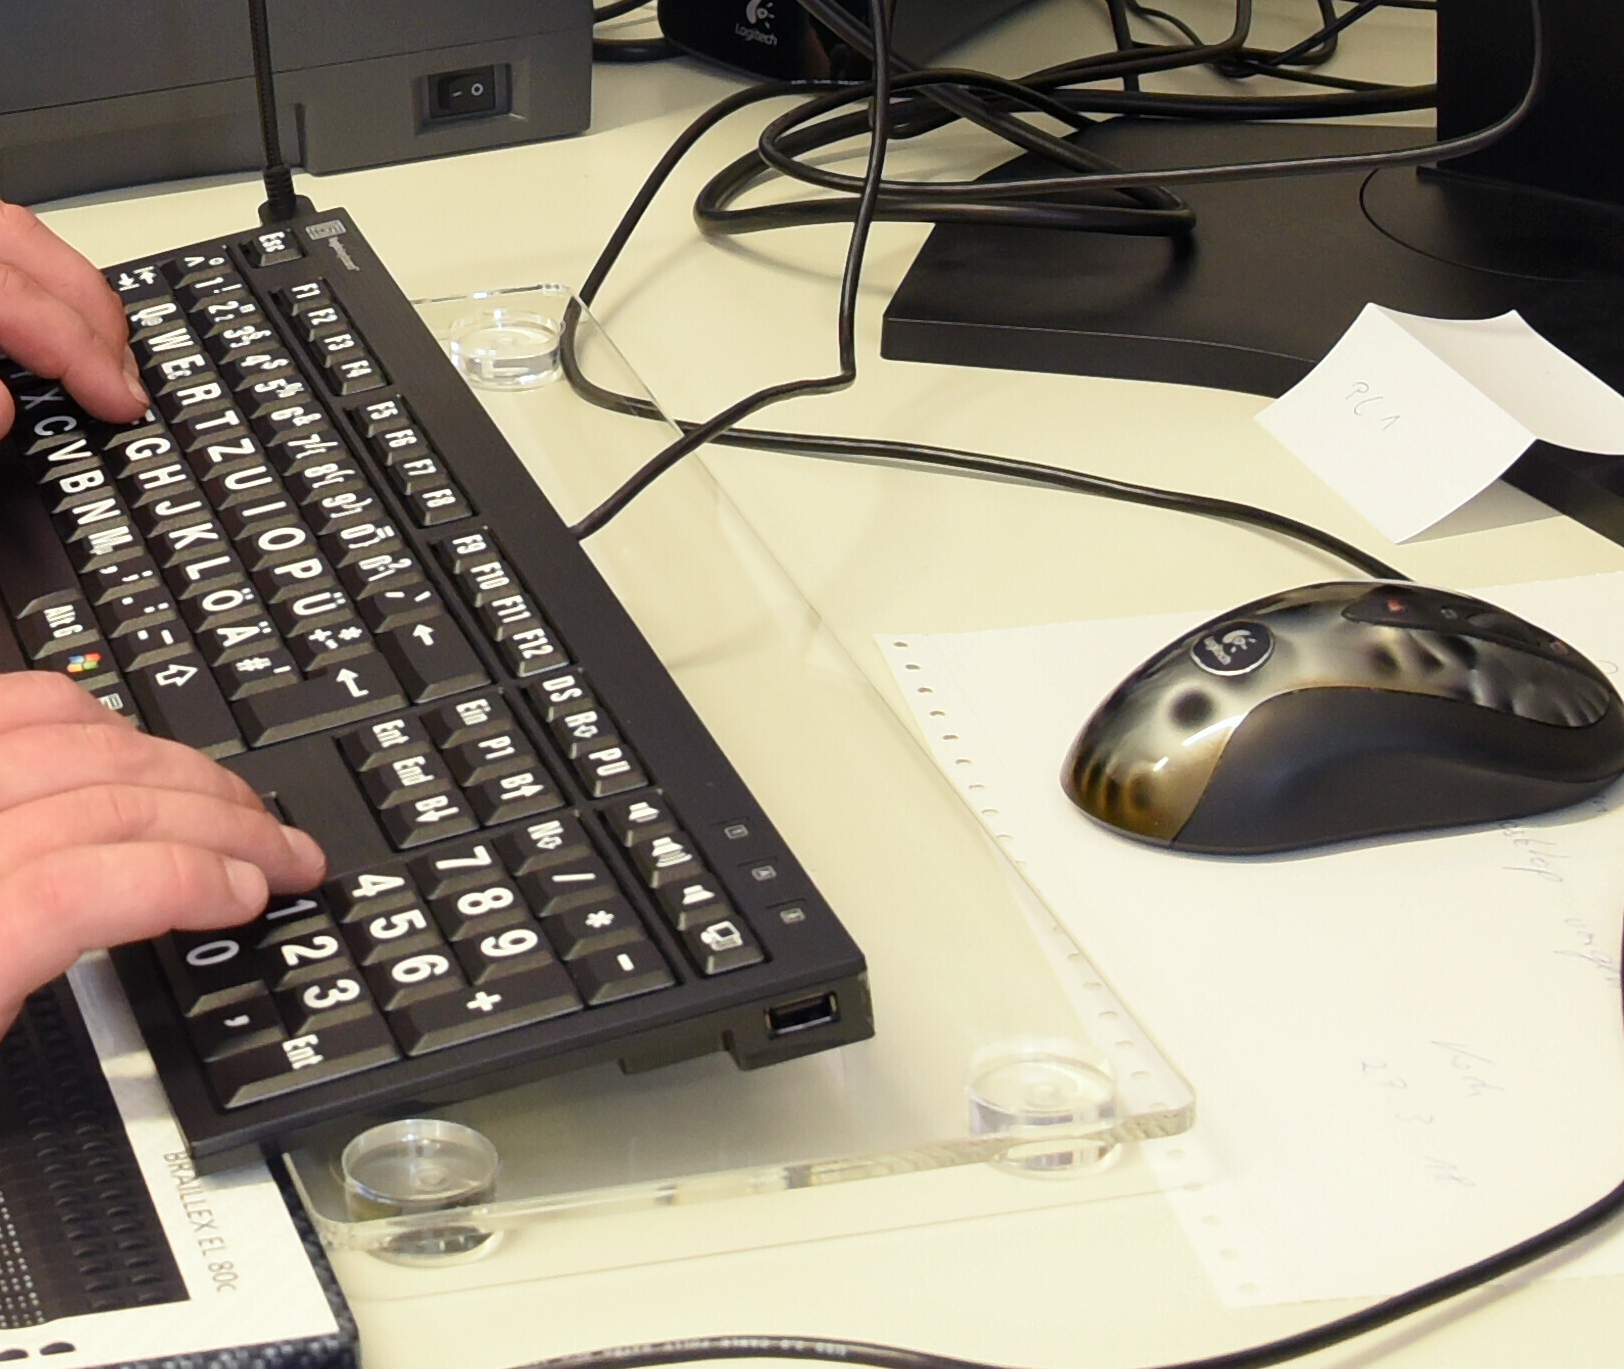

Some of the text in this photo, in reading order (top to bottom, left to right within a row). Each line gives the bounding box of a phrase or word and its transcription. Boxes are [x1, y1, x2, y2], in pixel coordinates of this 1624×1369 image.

[259, 232, 285, 252] Esc
[148, 327, 195, 352] W
[292, 283, 373, 379] F1 F2 F3 F4
[20, 387, 65, 410] X
[177, 382, 222, 406] R
[34, 416, 77, 436] C
[195, 409, 241, 431] T
[48, 438, 93, 462] V
[125, 437, 171, 462] G
[207, 437, 256, 463] Z
[367, 400, 457, 509] F5 F6 F7 F8
[60, 469, 105, 494] B
[138, 463, 187, 490] H
[225, 465, 273, 490] U
[72, 497, 122, 525] N
[155, 500, 203, 516] J
[242, 500, 287, 517] I
[169, 522, 220, 550] K
[258, 526, 307, 551] O
[185, 555, 231, 581] L
[274, 557, 323, 579] P
[201, 587, 255, 612] Ö
[293, 591, 347, 616] Ü
[451, 533, 554, 660] F9 F10 F11 F12
[217, 621, 272, 648] Ä
[455, 698, 492, 726] Ein
[542, 674, 583, 703] DS
[588, 747, 631, 777] PU
[435, 845, 493, 870] 7
[456, 887, 515, 916] 8
[351, 874, 450, 984] 4 5 6
[186, 939, 240, 966] 0
[480, 928, 539, 958] 9
[265, 899, 361, 1070] 1 2 3 Ent
[162, 1149, 219, 1233] BRAILLEX
[197, 1235, 227, 1258] EL
